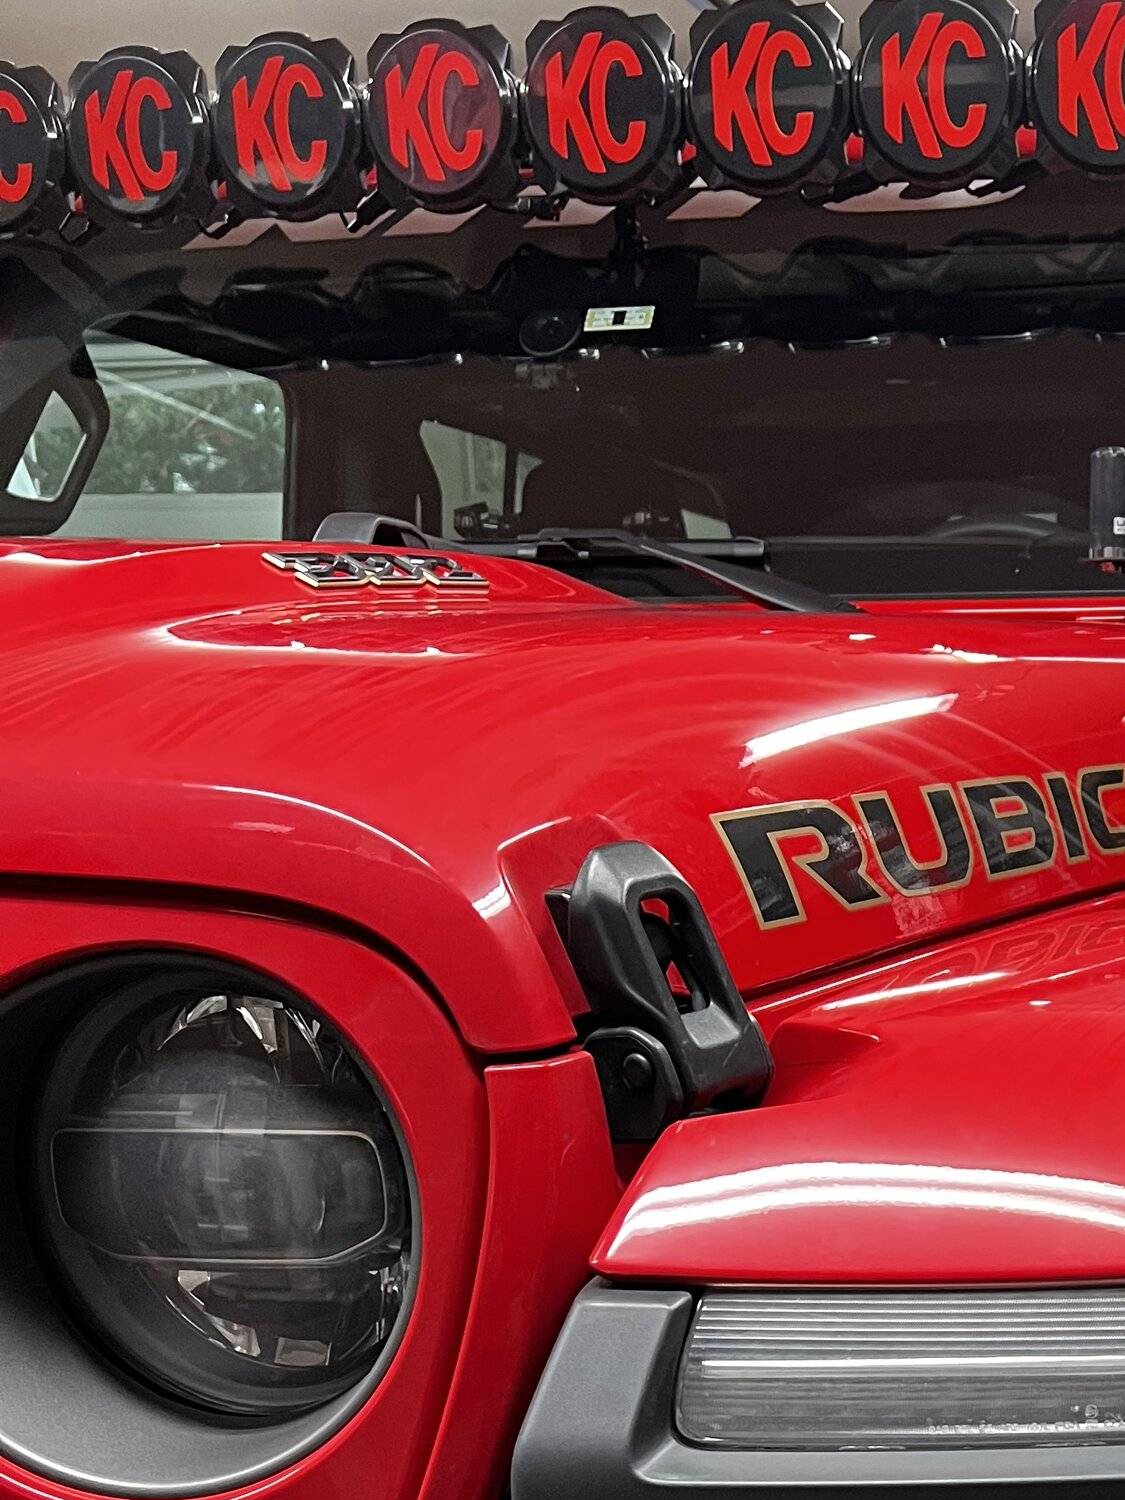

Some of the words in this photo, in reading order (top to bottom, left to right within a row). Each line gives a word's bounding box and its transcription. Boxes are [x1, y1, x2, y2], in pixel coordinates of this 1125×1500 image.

[0, 90, 33, 202] C
[84, 69, 178, 202] KC
[231, 55, 328, 192] KC
[384, 42, 484, 182] KC
[544, 31, 646, 174] KC
[710, 20, 814, 166] KC
[881, 12, 987, 159] KC
